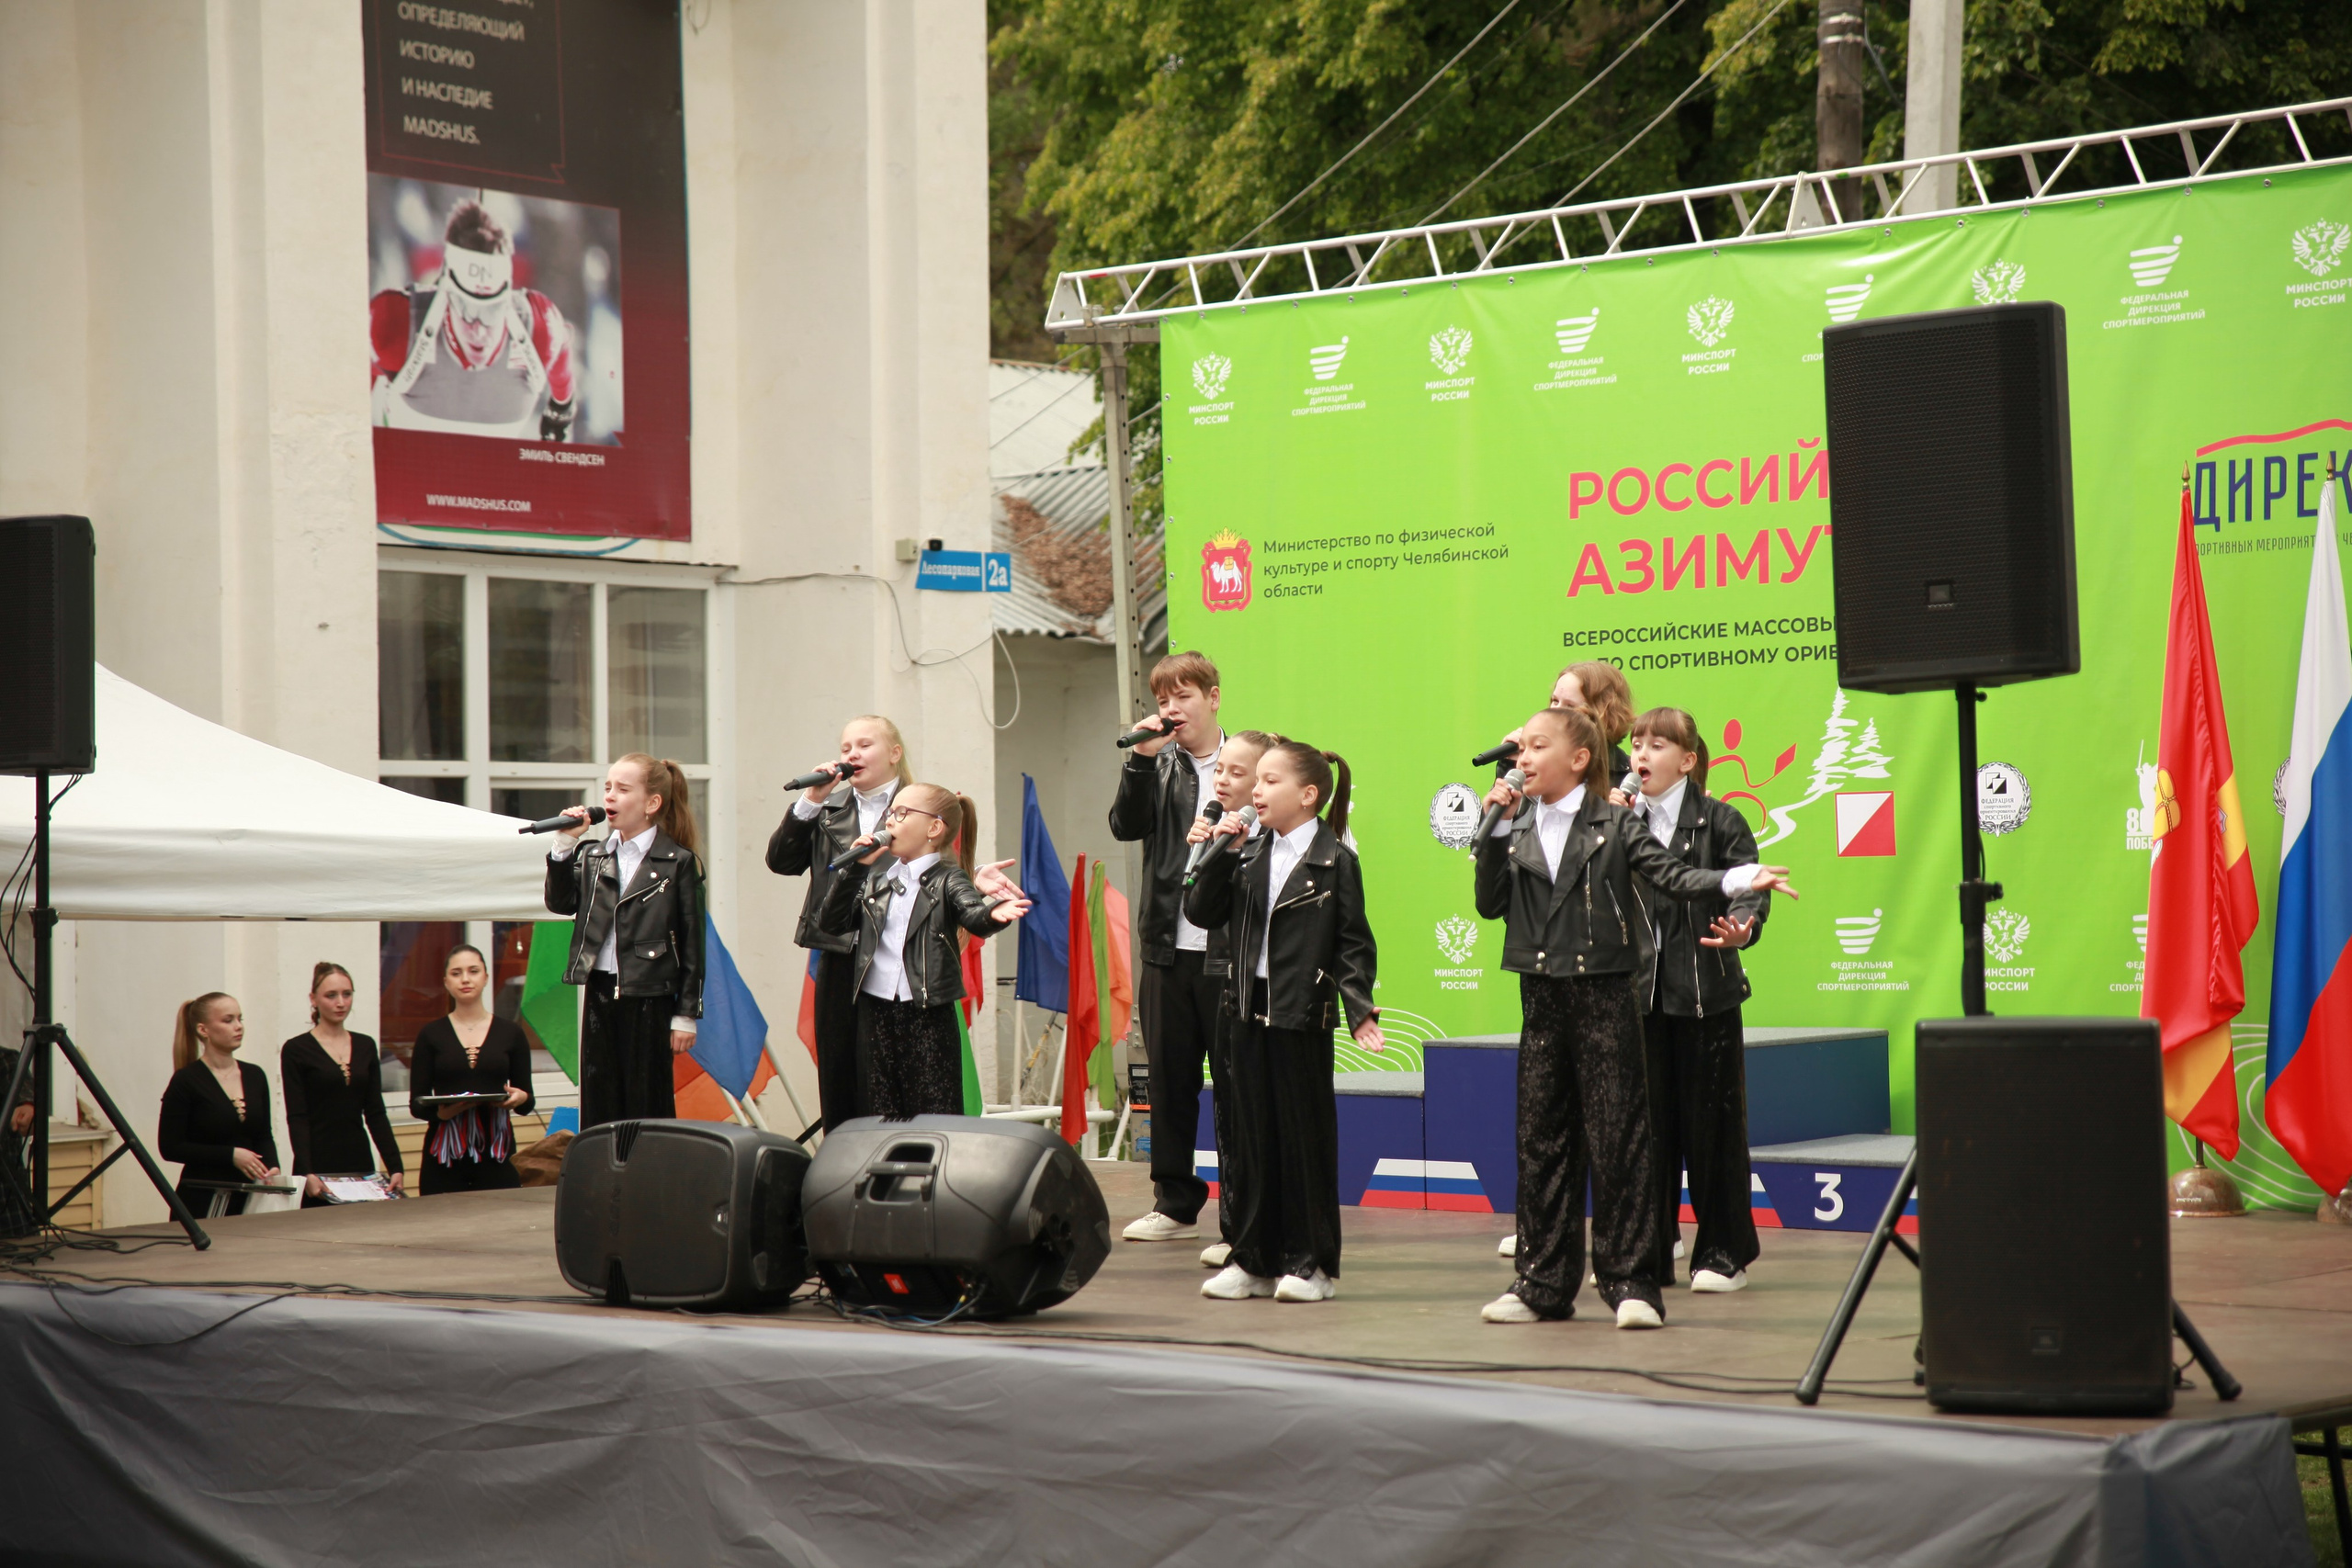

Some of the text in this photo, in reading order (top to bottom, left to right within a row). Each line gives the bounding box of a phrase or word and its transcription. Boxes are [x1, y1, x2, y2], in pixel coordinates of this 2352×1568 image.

[398, 2, 525, 40] ОПРЕДЕЛЯЮЩИЙ
[400, 39, 474, 69] ИСТОРИЮ
[401, 77, 494, 109] И НАСЛЕДИЕ
[403, 114, 481, 145] MADSHUS.
[2286, 277, 2352, 294] МИНСПОРТ
[2120, 289, 2189, 305] ФЕДЕРАЛЬНАЯ
[2294, 294, 2346, 308] РОССИИ
[2128, 302, 2181, 316] ДИРЕКЦИЯ
[2103, 309, 2205, 329] СПОРТМЕРОПРИЯТИЙ
[1548, 356, 1603, 369] ФЕДЕРАЛЬНАЯ
[1681, 348, 1736, 362] МИНСПОРТ
[1554, 367, 1597, 379] ДИРЕКЦИЯ
[1689, 363, 1729, 375] РОССИИ
[1304, 384, 1353, 396] ФЕДЕРАЛЬНАЯ
[1425, 377, 1475, 389] МИНСПОРТ
[1533, 375, 1617, 390] СПОРТМЕРОПРИЯТИЙ
[1309, 394, 1347, 405] ДИРЕКЦИЯ
[1431, 390, 1469, 401] РОССИИ
[1189, 401, 1235, 413] МИНСПОРТ
[1292, 400, 1366, 416] СПОРТМЕРОПРИЯТИЙ
[1194, 414, 1229, 425] РОССИИ
[519, 447, 605, 467] ЭМИЛЬ СВЕНДСЕН
[1569, 436, 1828, 520] РОССИЙ
[426, 493, 532, 512] WWW.MADSHUS.COM
[1263, 522, 1495, 553] Министерство по физической
[1263, 544, 1509, 579] культуре и спорту Челябинской
[1566, 524, 1832, 598] АЗИМУ
[922, 558, 1008, 586] Лесопарковая 2а
[1263, 583, 1323, 598] области
[1563, 622, 1728, 647] ВСЕРОССИЙСКИЕ
[1629, 648, 1779, 671] СПОРТИВНОМУ
[1434, 968, 1483, 977] МИНСПОРТ
[1831, 961, 1893, 971] ФЕДЕРАЛЬНАЯ
[1984, 967, 2035, 977] ИНСПОРТ
[1838, 972, 1886, 982] ДИРЕКЦИЯ
[1441, 981, 1478, 990] РОССИИ
[1817, 980, 1909, 991] СПОРТМЕРОПРИЯТИЙ
[1814, 1172, 1844, 1222] 3
